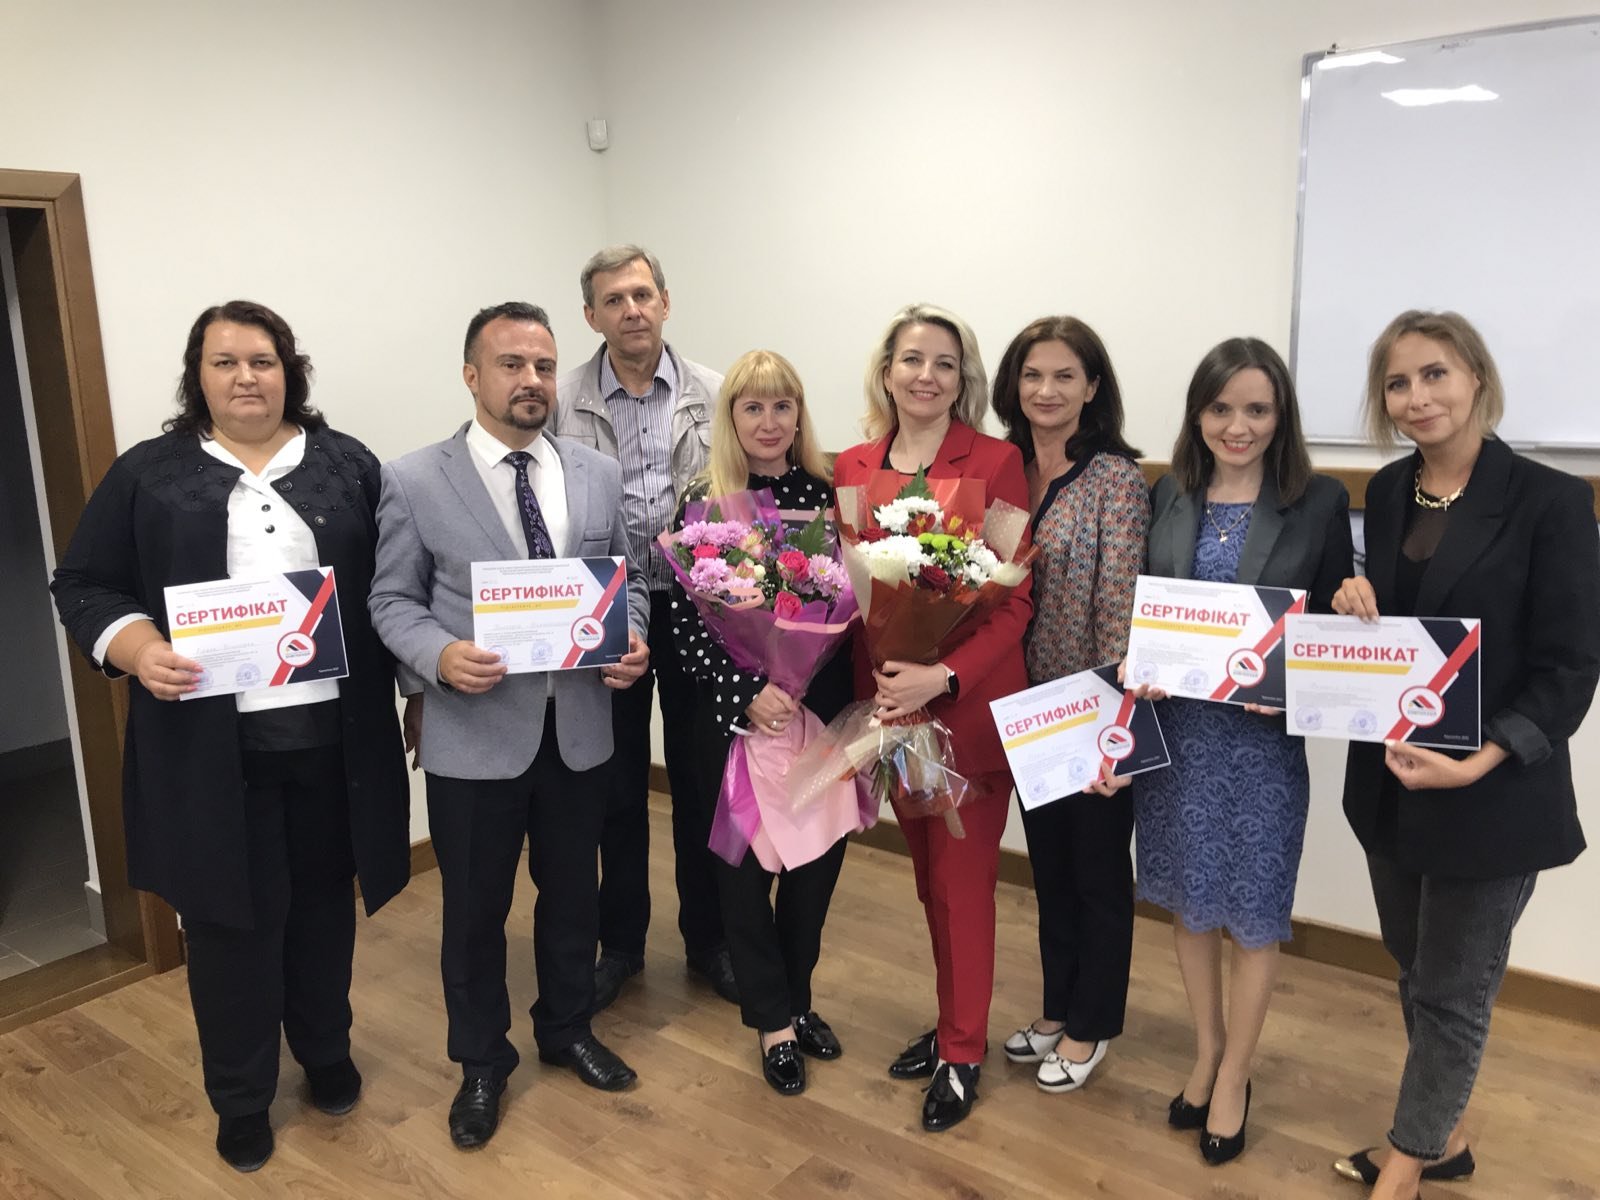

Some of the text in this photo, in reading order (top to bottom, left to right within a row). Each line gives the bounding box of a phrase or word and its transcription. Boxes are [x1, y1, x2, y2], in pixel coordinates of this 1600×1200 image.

[479, 584, 584, 602] СЕРТИФІКАТ
[176, 599, 288, 626] СЕРТИФІКАТ
[1140, 603, 1251, 627] СЕРТИФІКАТ
[1293, 643, 1419, 663] СЕРТИФІКАТ
[1005, 695, 1100, 737] СЕРТИФІКАТ
